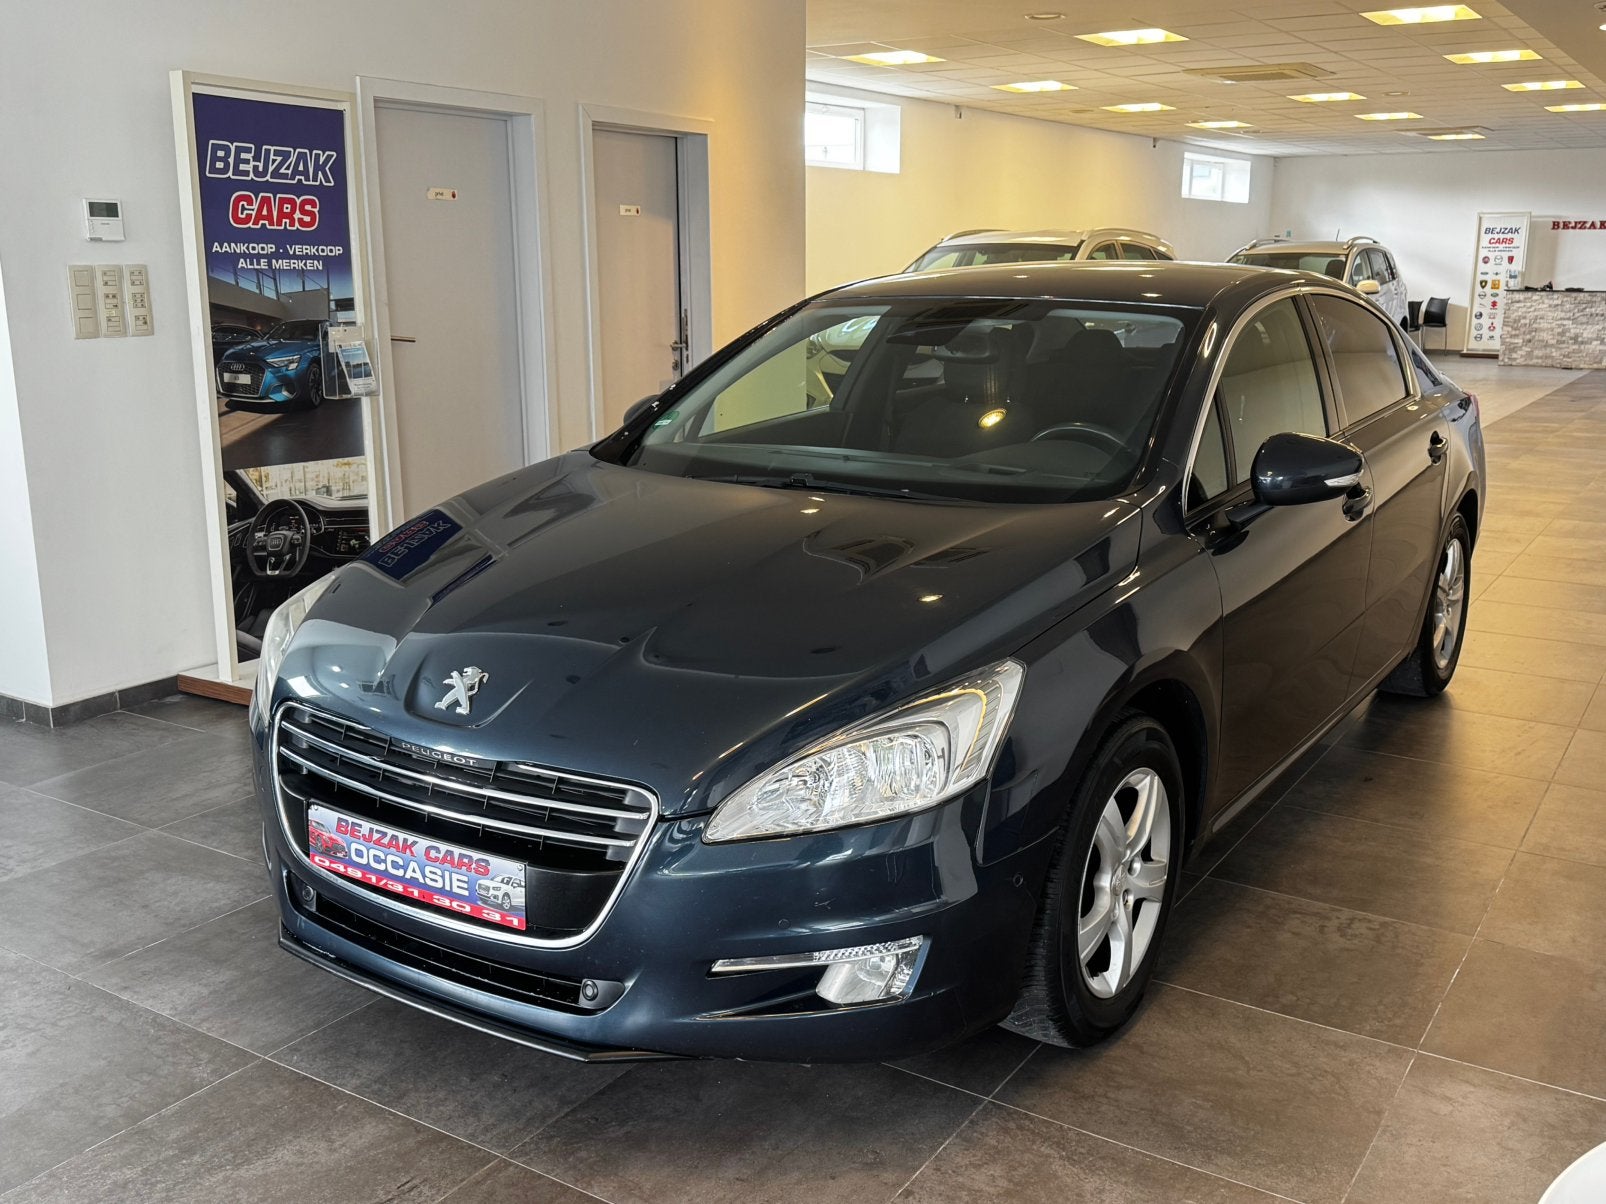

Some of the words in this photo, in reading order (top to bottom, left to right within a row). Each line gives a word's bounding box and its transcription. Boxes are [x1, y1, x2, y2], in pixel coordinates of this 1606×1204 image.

[206, 140, 336, 186] BEJZAK
[229, 191, 320, 231] CARS
[1484, 227, 1521, 235] BEJZAK
[1488, 237, 1514, 245] CARS
[212, 242, 275, 254] AANKOOP
[286, 244, 343, 257] VERKOOP
[238, 258, 268, 269] ALLE
[272, 259, 323, 270] MERKEN
[402, 742, 478, 766] PEUGEOT
[335, 816, 418, 857] BEJZAK
[424, 844, 491, 876] CARS
[350, 842, 470, 896] OCCASIE
[433, 895, 471, 913] 30
[482, 909, 519, 926] 31
